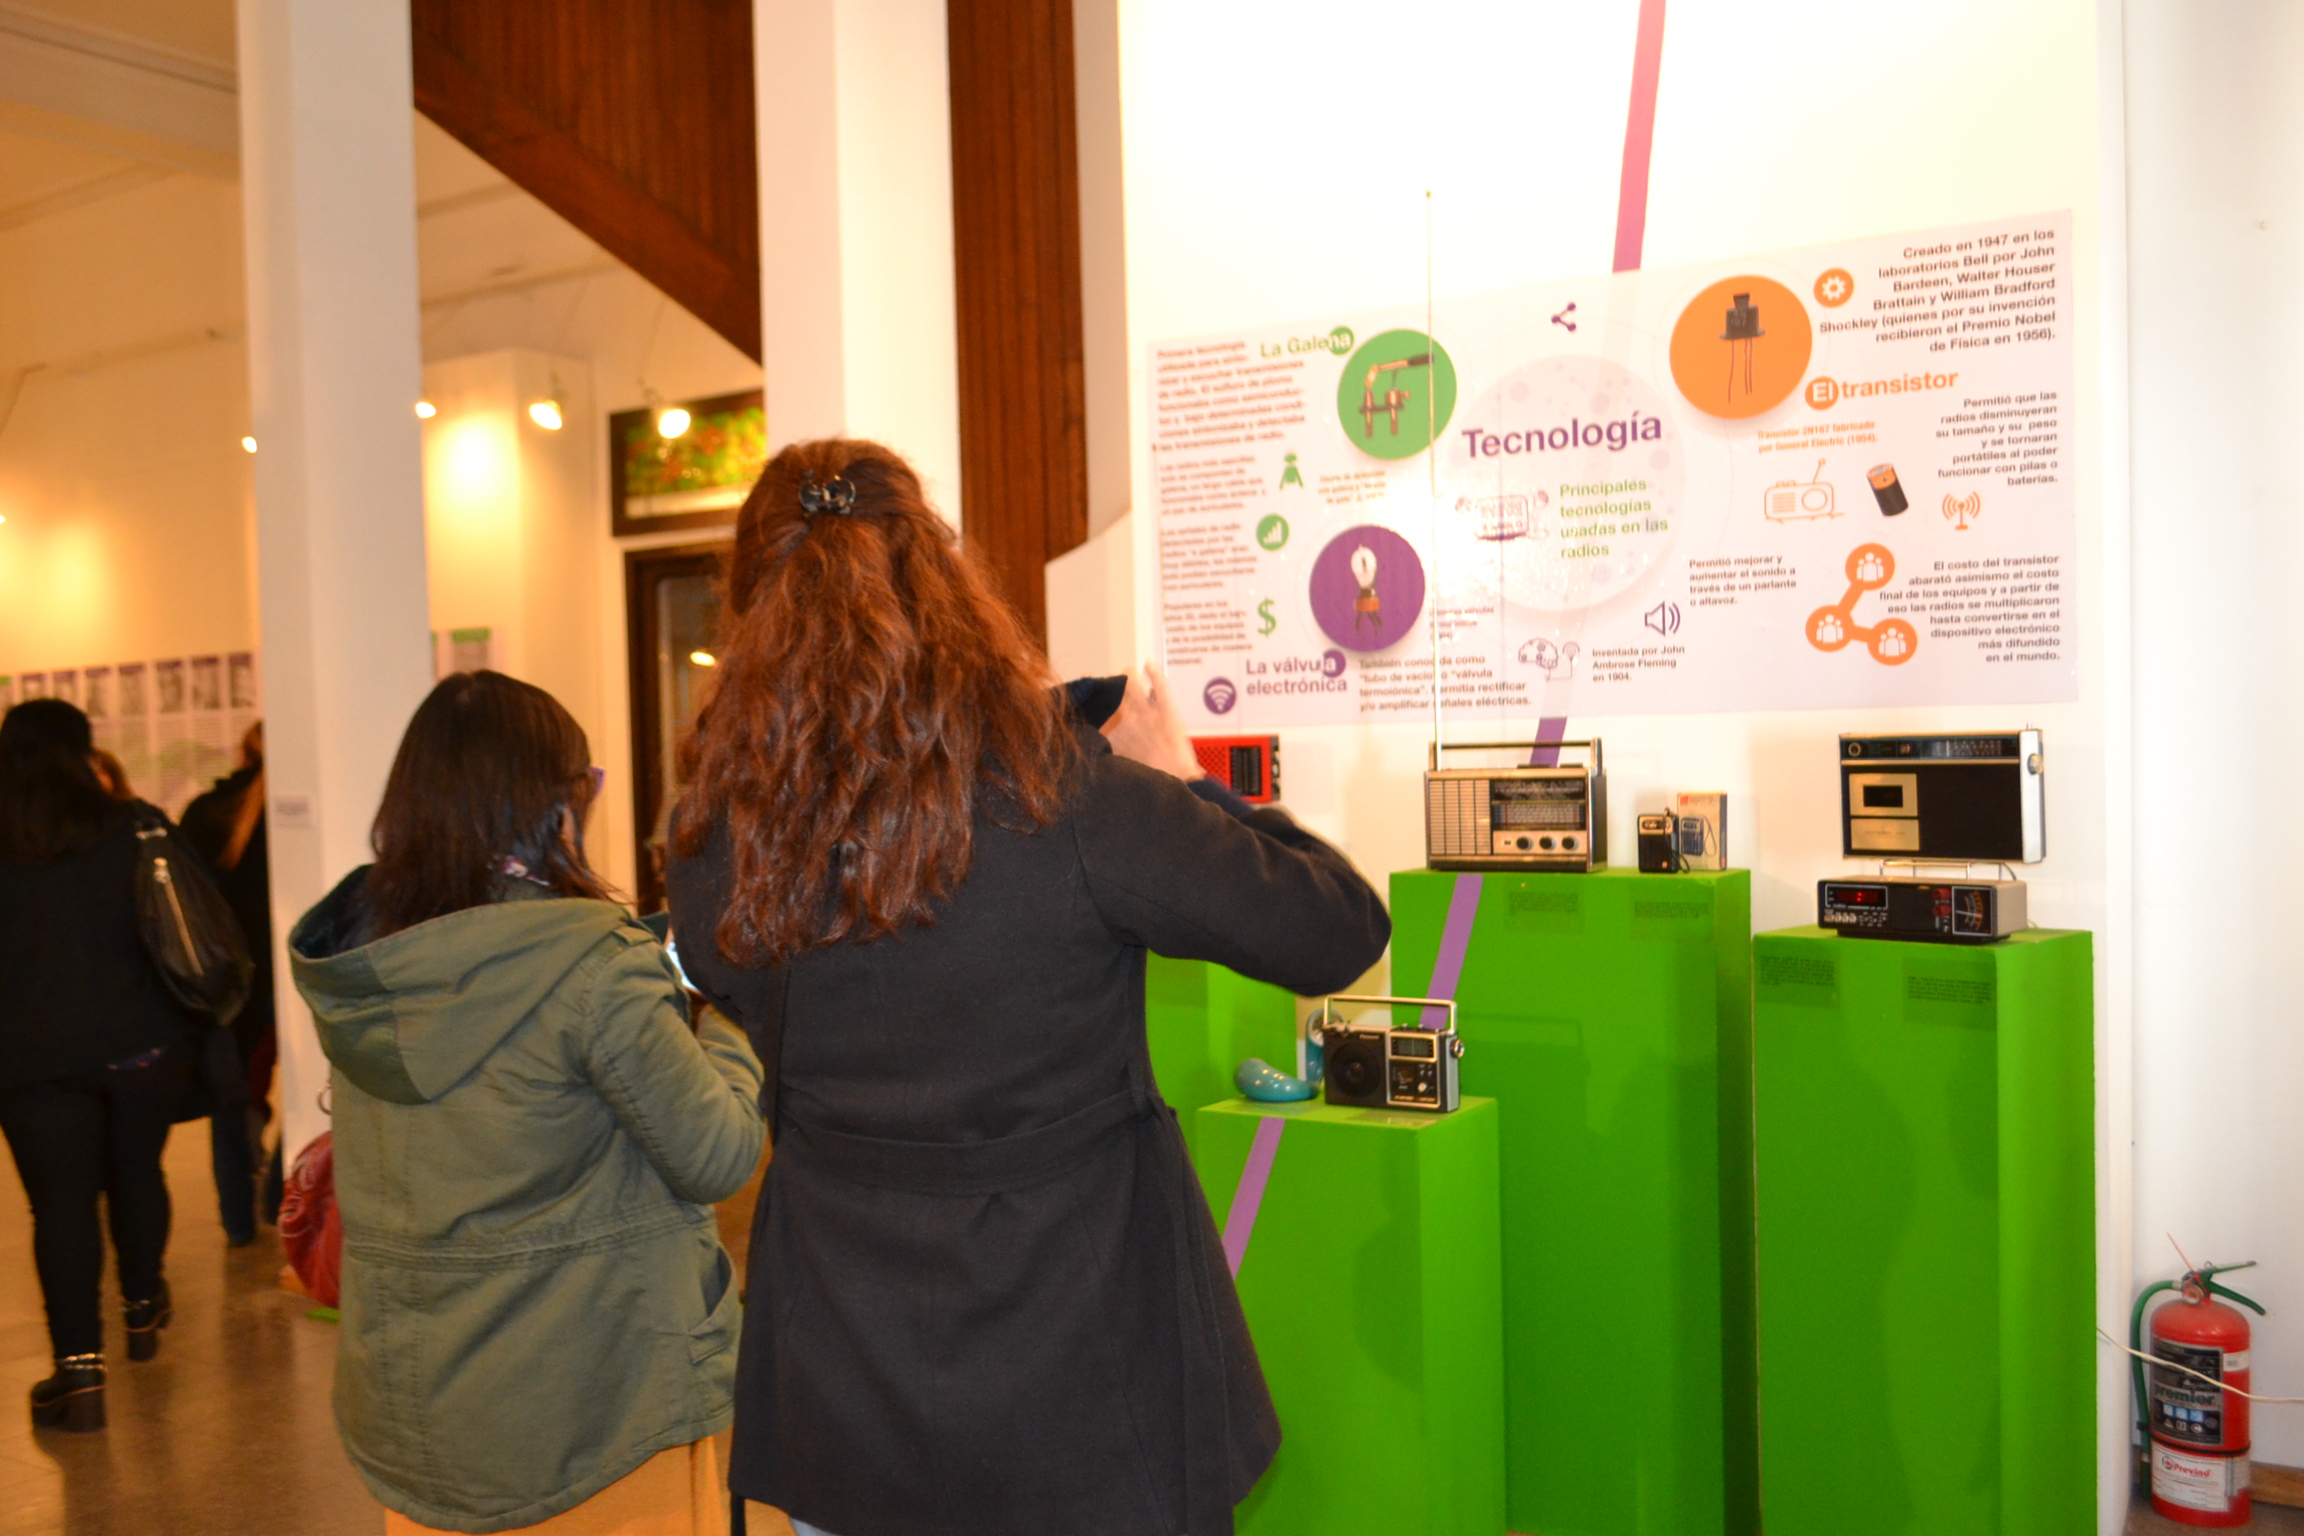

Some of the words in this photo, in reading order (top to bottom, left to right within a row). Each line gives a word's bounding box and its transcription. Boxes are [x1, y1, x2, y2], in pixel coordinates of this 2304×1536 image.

[1903, 243, 1951, 258] Creado
[1956, 241, 1972, 251] en
[1978, 235, 2007, 248] 1947
[2013, 233, 2029, 243] en
[2034, 230, 2054, 240] los
[1878, 260, 1959, 278] laboratorios
[1963, 253, 1988, 267] Bell
[1993, 252, 2016, 264] por
[2020, 246, 2054, 259] John
[1893, 277, 1952, 292] Bardeen,
[1957, 270, 2000, 283] Walter
[2005, 263, 2055, 277] Houser
[1873, 296, 1925, 311] Brattain
[1929, 295, 1936, 305] y
[1940, 288, 1989, 302] William
[1994, 277, 2055, 295] Bradford
[1882, 311, 1937, 327] (quienes
[1942, 308, 1964, 320] por
[1969, 305, 1984, 314] su
[1989, 296, 2055, 312] invención
[1876, 326, 1942, 342] recibieron
[1946, 322, 1957, 333] el
[1962, 318, 2010, 332] Premio
[2015, 310, 2055, 325] Nobel
[1260, 342, 1281, 358] La
[1287, 331, 1350, 354] Galena
[1930, 341, 1946, 351] de
[1950, 337, 1990, 349] Física
[1994, 334, 2010, 344] en
[1812, 382, 1833, 402] El
[1842, 372, 1958, 399] transistor
[1964, 395, 2011, 408] Permitió
[2015, 394, 2036, 404] que
[2040, 392, 2057, 400] las
[1941, 414, 1976, 423] radios
[1979, 406, 2057, 419] disminuyeran
[1461, 410, 1661, 459] Tecnología
[1952, 424, 1995, 436] tamaño
[1998, 425, 2004, 434] y
[2028, 420, 2057, 430] peso
[1981, 440, 1987, 449] y
[1991, 438, 2004, 446] se
[2007, 433, 2057, 444] tornaran
[1953, 451, 2006, 464] portátiles
[2010, 449, 2020, 458] al
[2023, 446, 2057, 458] poder
[1938, 466, 1991, 477] funcionar
[1995, 464, 2016, 473] con
[2019, 461, 2046, 472] pilas
[1560, 479, 1646, 497] Principales
[2007, 475, 2057, 485] baterías.
[1560, 500, 1651, 518] tecnologías
[1560, 523, 1616, 539] usadas
[1621, 522, 1640, 533] en
[1646, 519, 1668, 531] las
[1561, 544, 1609, 559] radios
[1689, 558, 1731, 568] Permitió
[1734, 556, 1773, 566] mejorar
[1777, 556, 1782, 564] y
[1934, 561, 1944, 570] El
[1947, 560, 1979, 569] costo
[1982, 558, 1999, 567] del
[2003, 555, 2058, 566] transistor
[1690, 571, 1736, 581] aumentar
[1740, 568, 1749, 577] el
[1752, 567, 1786, 577] sonido
[1909, 575, 1951, 585] abarató
[1955, 573, 2009, 582] asimismo
[2013, 570, 2023, 579] el
[2026, 569, 2059, 578] costo
[1690, 584, 1720, 593] través
[1723, 583, 1736, 591] de
[1754, 580, 1796, 591] parlante
[1880, 590, 1902, 600] final
[1906, 590, 1919, 599] de
[1922, 589, 1939, 598] los
[1942, 588, 1987, 598] equipos
[1990, 587, 1996, 596] y
[2010, 583, 2041, 594] partir
[2045, 582, 2059, 591] de
[1888, 605, 1907, 613] eso
[1910, 603, 1926, 612] las
[1929, 601, 1964, 610] radios
[1984, 597, 2059, 608] multiplicaron
[1930, 615, 1960, 624] hasta
[1964, 612, 2028, 622] convertirse
[2049, 609, 2059, 618] el
[1930, 627, 1991, 638] dispositivo
[1995, 624, 2060, 634] electrónico
[1978, 640, 2002, 648] más
[2006, 637, 2060, 648] difundido
[1592, 647, 1639, 657] Inventada
[1642, 648, 1657, 656] por
[1661, 645, 1684, 654] John
[2003, 652, 2013, 661] el
[2016, 651, 2059, 660] mundo.
[1246, 659, 1266, 674] La
[1455, 655, 1485, 665] como
[1592, 660, 1635, 669] Ambrose
[1638, 659, 1676, 668] Fleming
[1390, 672, 1402, 681] de
[1246, 677, 1347, 695] electrónica
[1478, 681, 1526, 693] rectificar
[1379, 699, 1429, 711] amplificar
